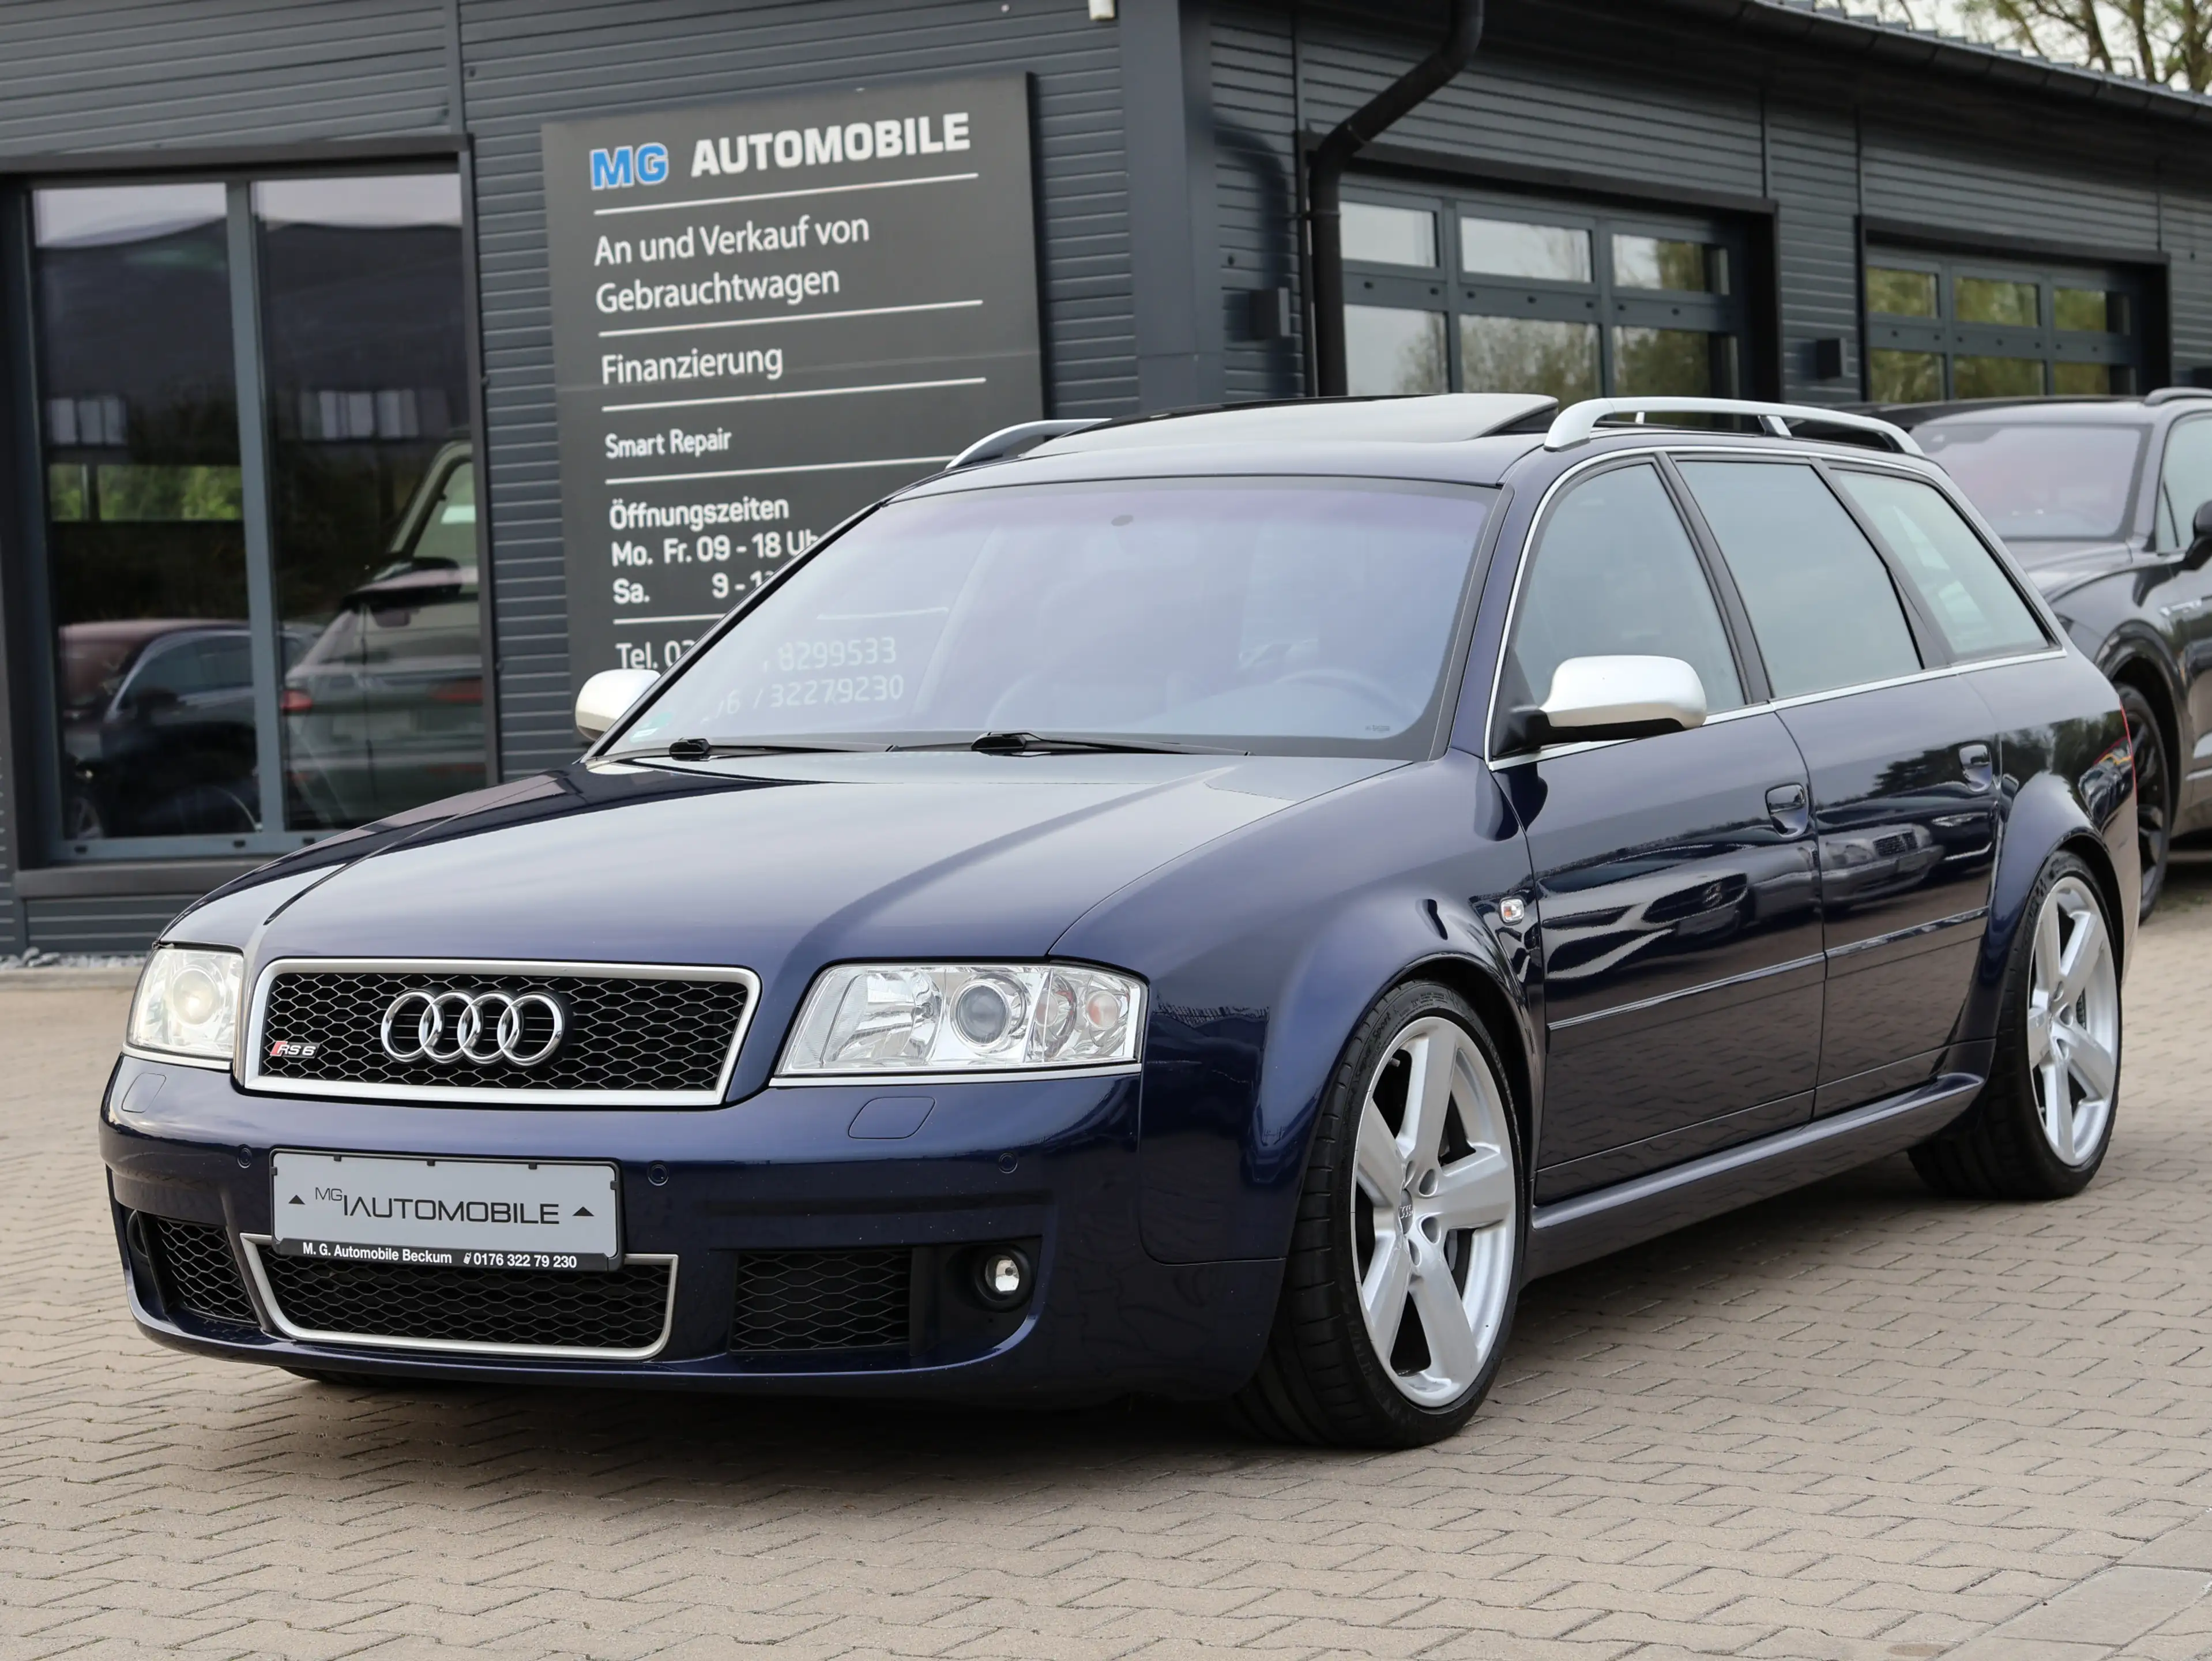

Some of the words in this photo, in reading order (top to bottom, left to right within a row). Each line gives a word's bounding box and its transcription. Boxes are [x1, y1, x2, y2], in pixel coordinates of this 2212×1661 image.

[589, 142, 669, 191] MG
[691, 112, 971, 177] AUTOMOBILE
[594, 235, 633, 266] An
[639, 226, 695, 262] und
[699, 214, 810, 256] Verkauf
[814, 218, 870, 245] von
[596, 269, 840, 313] Gebrauchtwagen
[601, 347, 784, 386] Finanzierung
[605, 433, 665, 459] Smart
[669, 427, 732, 457] Repair
[609, 497, 790, 532] Öffnungszeiten
[611, 540, 653, 567] Mo.
[663, 538, 692, 564] Fr.
[696, 534, 731, 562] 09
[751, 531, 782, 559] 18
[612, 578, 650, 604] Sa.
[712, 572, 729, 599] 9
[615, 641, 659, 669] Tel.
[769, 674, 904, 708] 32279230
[315, 1187, 343, 1201] MG
[303, 1242, 317, 1254] M.
[319, 1243, 332, 1256] G.
[334, 1244, 399, 1261] Automobile
[402, 1247, 452, 1264] Beckum
[473, 1252, 505, 1267] 0176
[507, 1253, 531, 1267] 322
[534, 1254, 550, 1267] 79
[553, 1254, 577, 1268] 230
